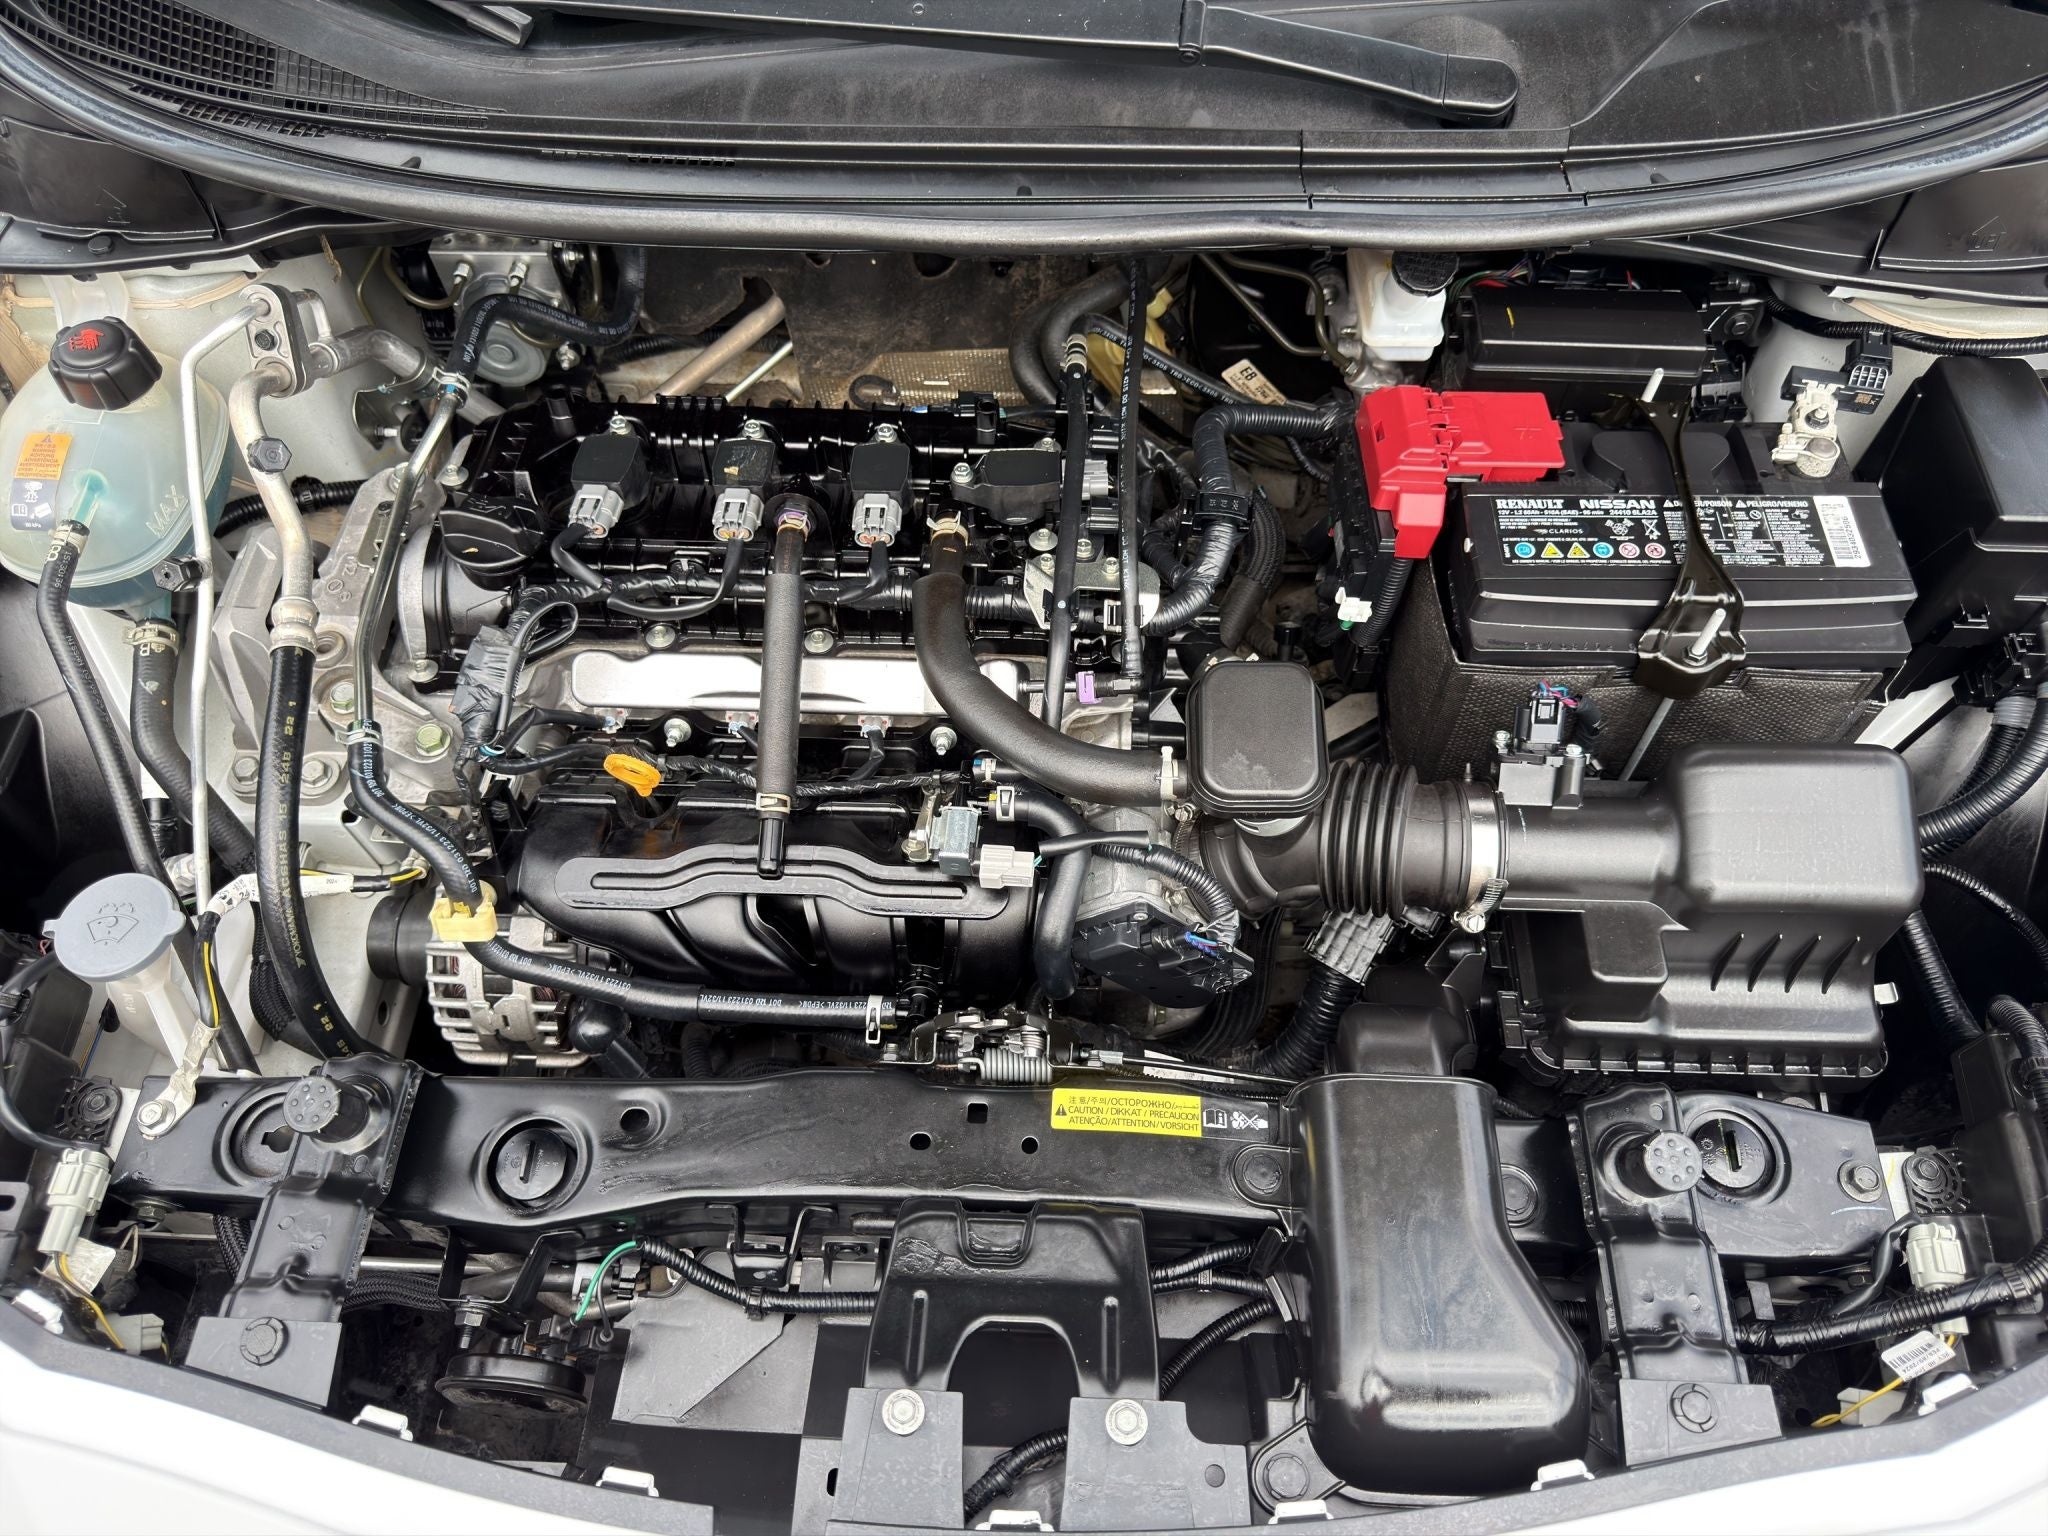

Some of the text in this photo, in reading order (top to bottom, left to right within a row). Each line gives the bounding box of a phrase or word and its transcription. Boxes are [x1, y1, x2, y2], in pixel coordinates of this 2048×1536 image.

[1496, 499, 1656, 509] RENAULT NISSAN
[146, 485, 187, 537] MAX
[439, 836, 464, 863] 031223
[605, 977, 631, 991] 031223
[728, 996, 754, 1005] 031223
[769, 999, 782, 1007] DOT
[1068, 1106, 1104, 1115] CAUTION
